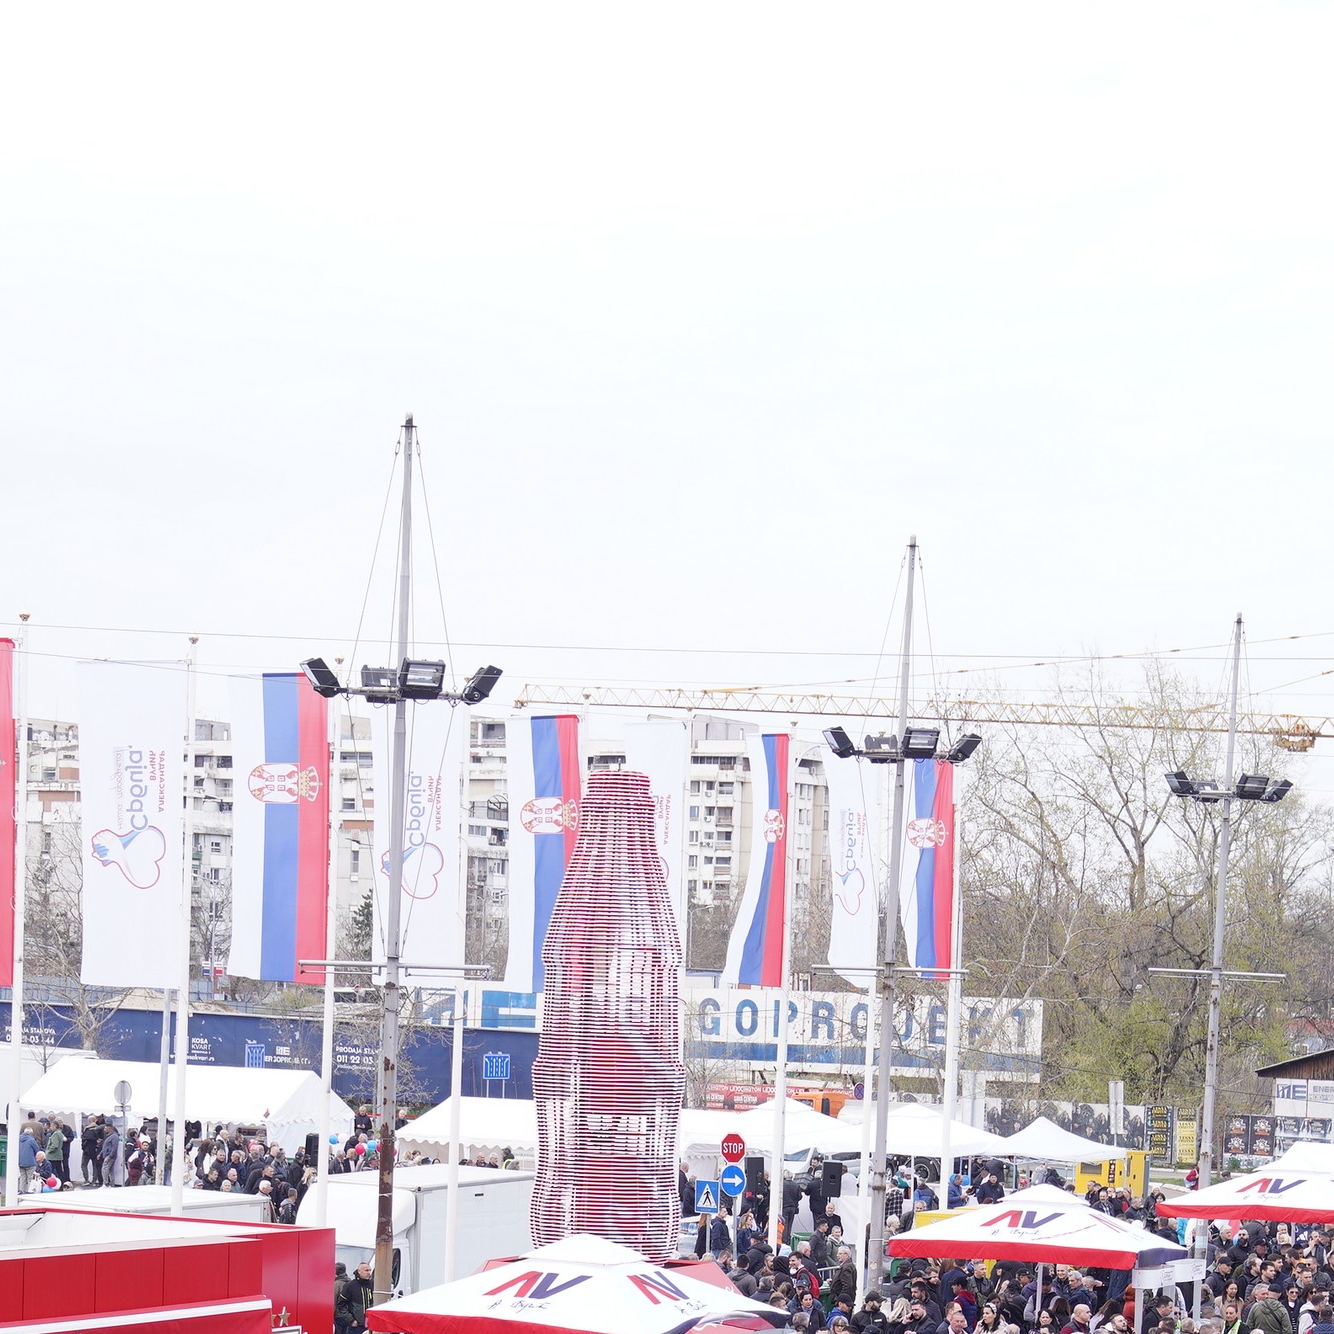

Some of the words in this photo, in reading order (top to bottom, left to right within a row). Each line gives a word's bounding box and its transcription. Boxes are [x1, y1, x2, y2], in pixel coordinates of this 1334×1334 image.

[336, 1055, 348, 1063] 011
[350, 1056, 360, 1064] 22
[723, 1142, 743, 1154] STOP
